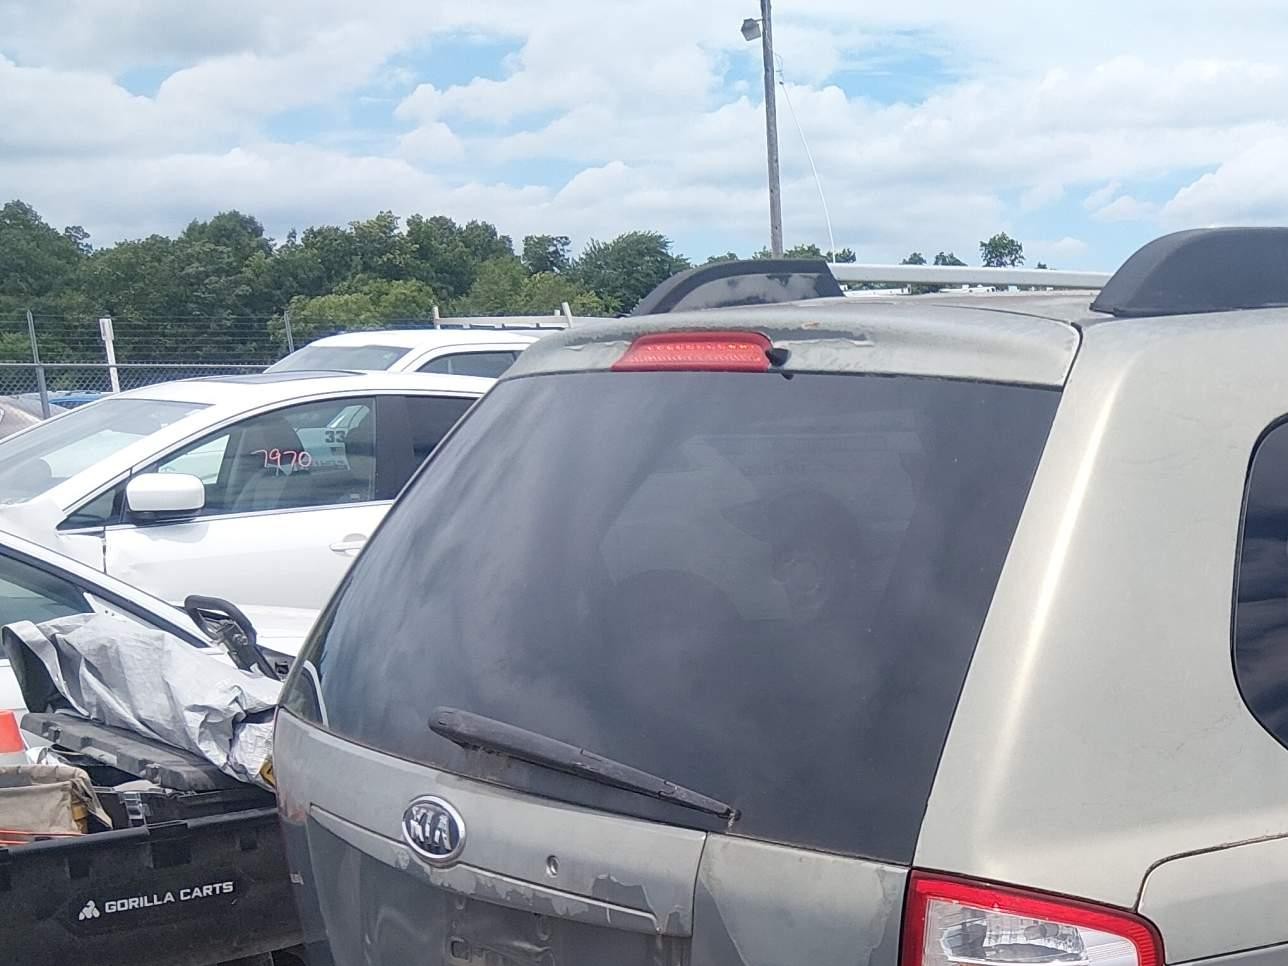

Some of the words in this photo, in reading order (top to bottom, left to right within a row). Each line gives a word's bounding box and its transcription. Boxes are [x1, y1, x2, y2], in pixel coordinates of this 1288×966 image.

[250, 448, 312, 477] 7970
[409, 805, 453, 851] KIA
[105, 892, 175, 913] GORILLA
[179, 881, 234, 901] CARTS
